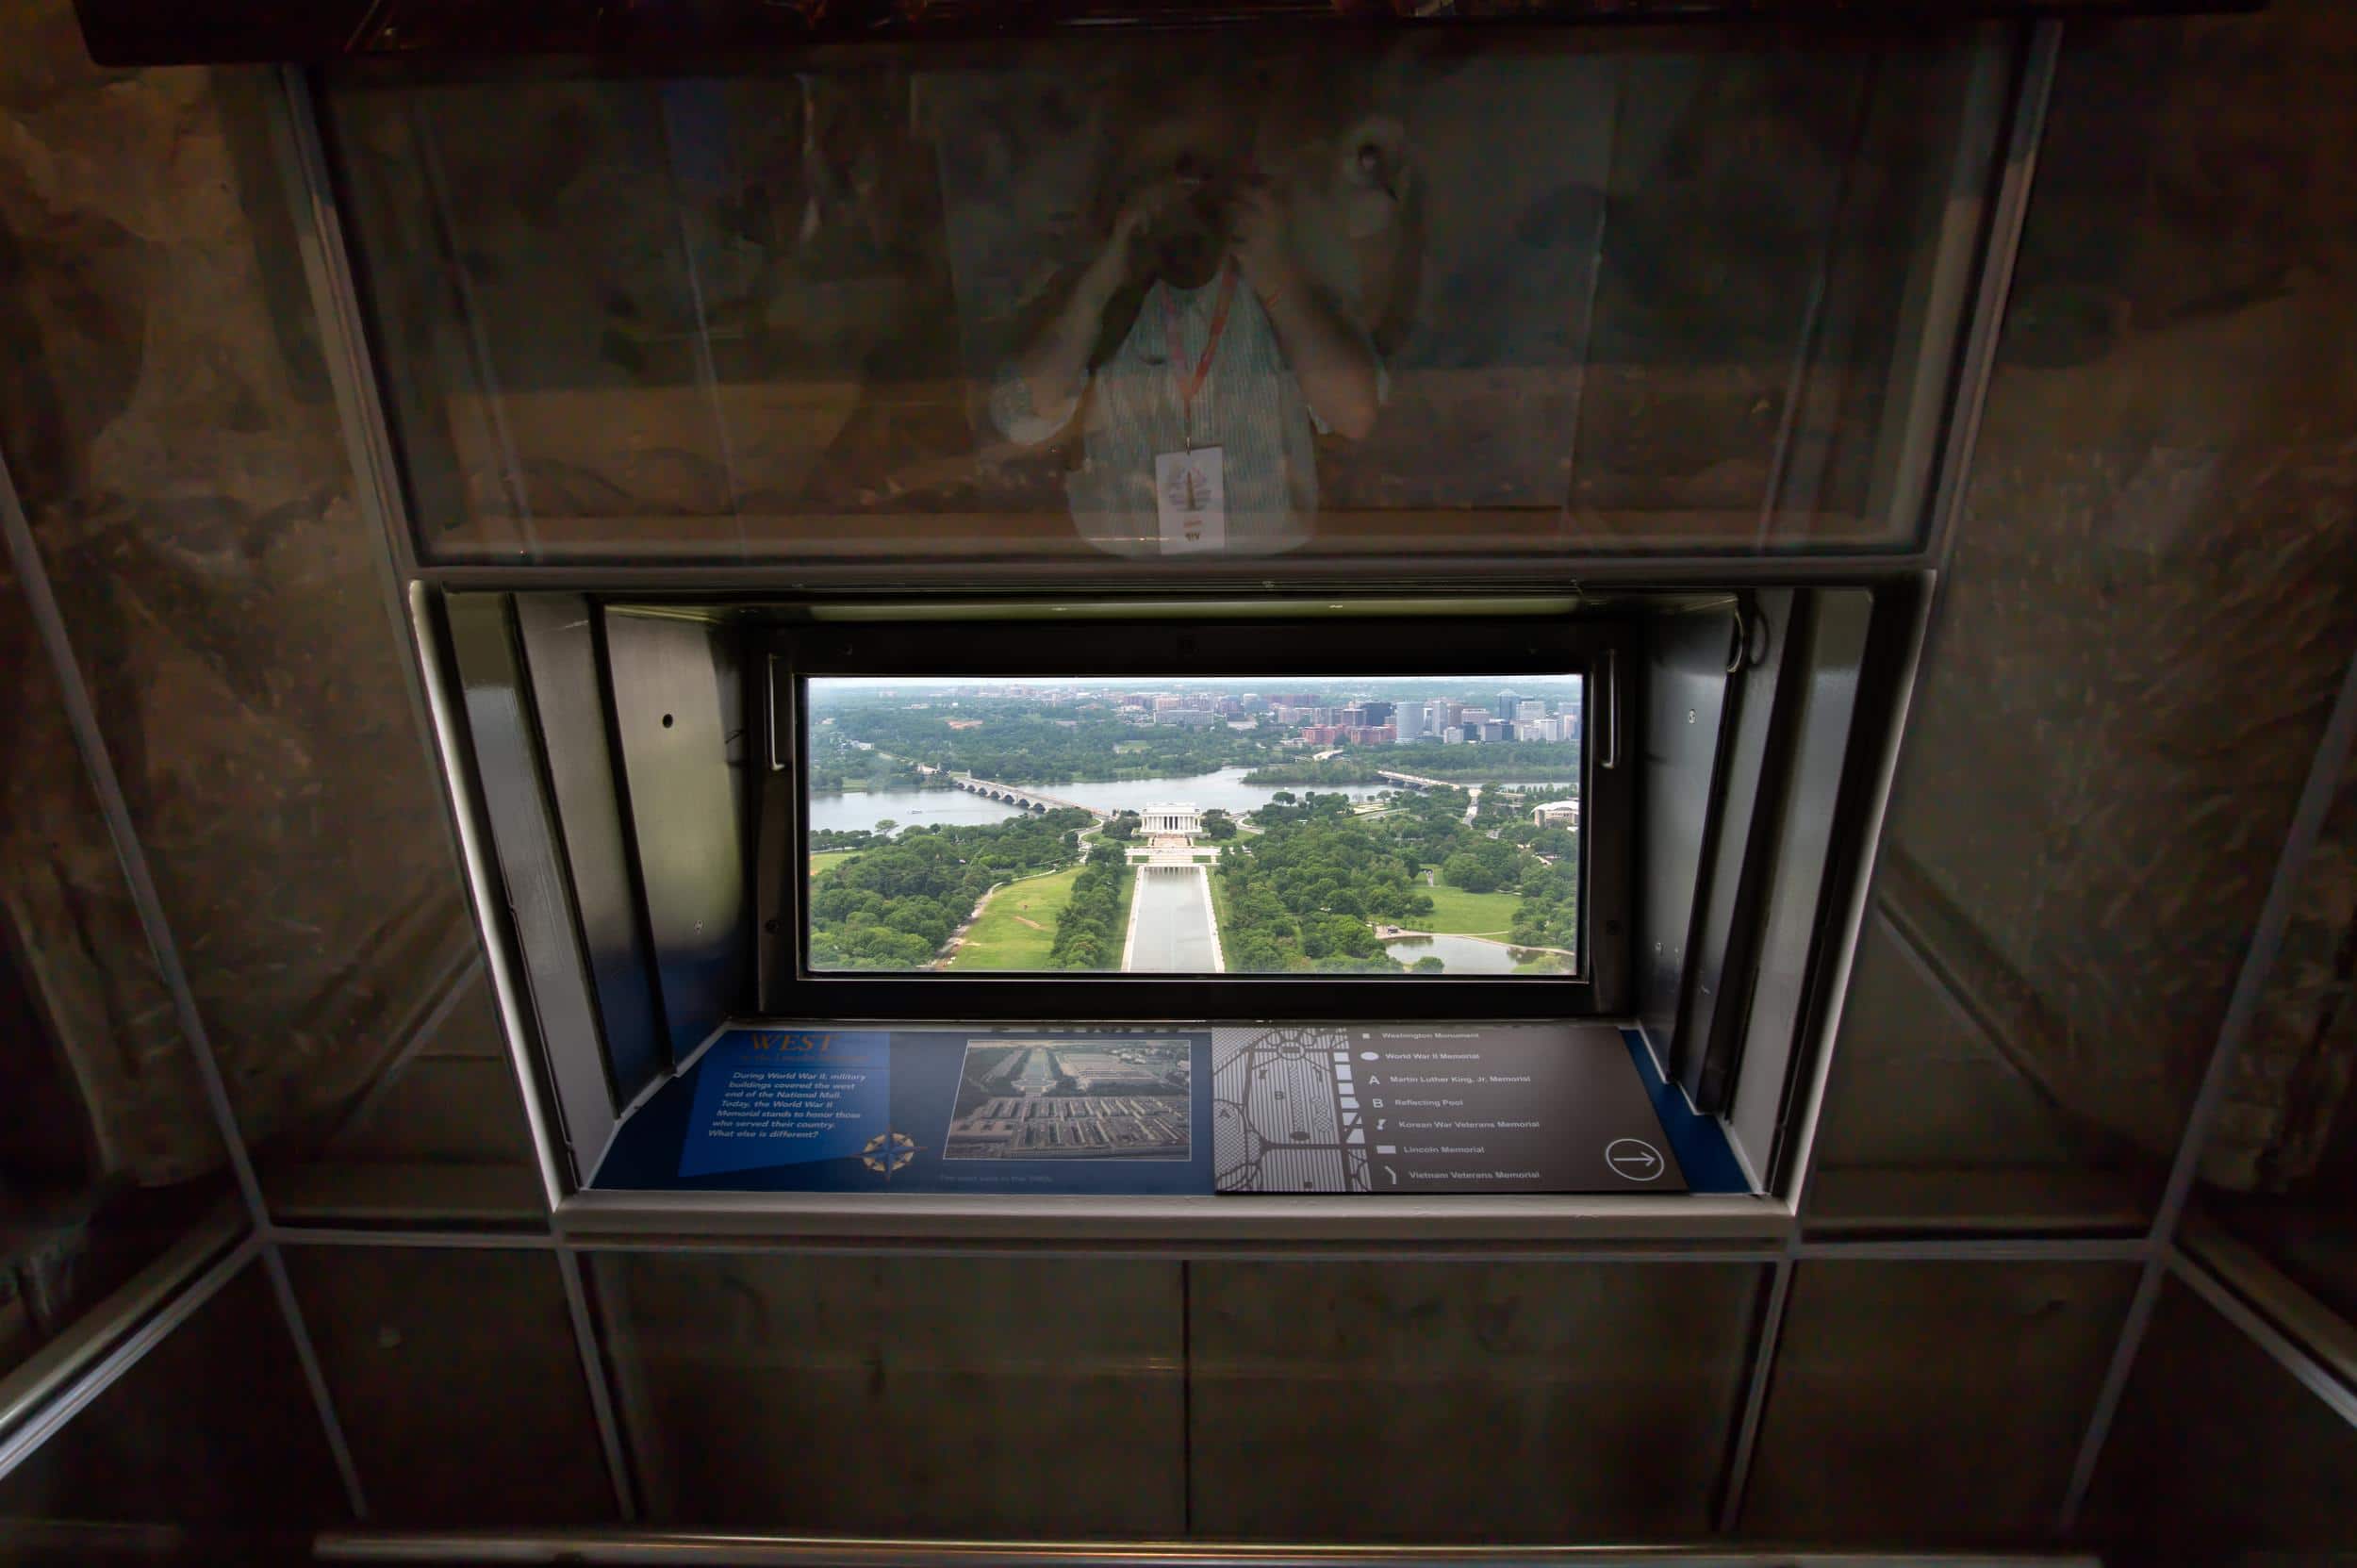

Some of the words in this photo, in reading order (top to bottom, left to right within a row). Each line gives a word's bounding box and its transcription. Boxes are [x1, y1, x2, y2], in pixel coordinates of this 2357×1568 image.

[1381, 1032, 1433, 1041] Washington
[750, 1032, 841, 1051] WEST
[733, 1072, 765, 1081] During
[830, 1073, 866, 1081] military
[1368, 1075, 1380, 1085] A
[1390, 1075, 1419, 1083] Martin
[1420, 1075, 1449, 1083] Luther
[1490, 1075, 1531, 1083] Memorial
[729, 1081, 771, 1090] buildings
[721, 1099, 751, 1109] Today,
[1372, 1098, 1384, 1109] B
[1394, 1098, 1442, 1108] Reflecting
[1442, 1098, 1464, 1107] Pool
[762, 1110, 792, 1118] stands
[794, 1110, 804, 1118] to
[806, 1110, 833, 1118] honor
[835, 1110, 861, 1118] those
[797, 1122, 836, 1131] country.
[1398, 1120, 1433, 1129] Korean
[1434, 1120, 1454, 1129] War
[1455, 1120, 1495, 1129] Veterans
[1497, 1120, 1540, 1129] Memorial
[708, 1130, 734, 1138] What
[736, 1130, 756, 1138] else
[758, 1130, 767, 1138] is
[769, 1131, 819, 1139] different?
[1404, 1146, 1440, 1154] Lincoln
[1442, 1146, 1486, 1154] Memorial
[1409, 1171, 1449, 1180] Vietnam
[1451, 1171, 1493, 1180] Veterans
[1495, 1171, 1540, 1180] Memorial
